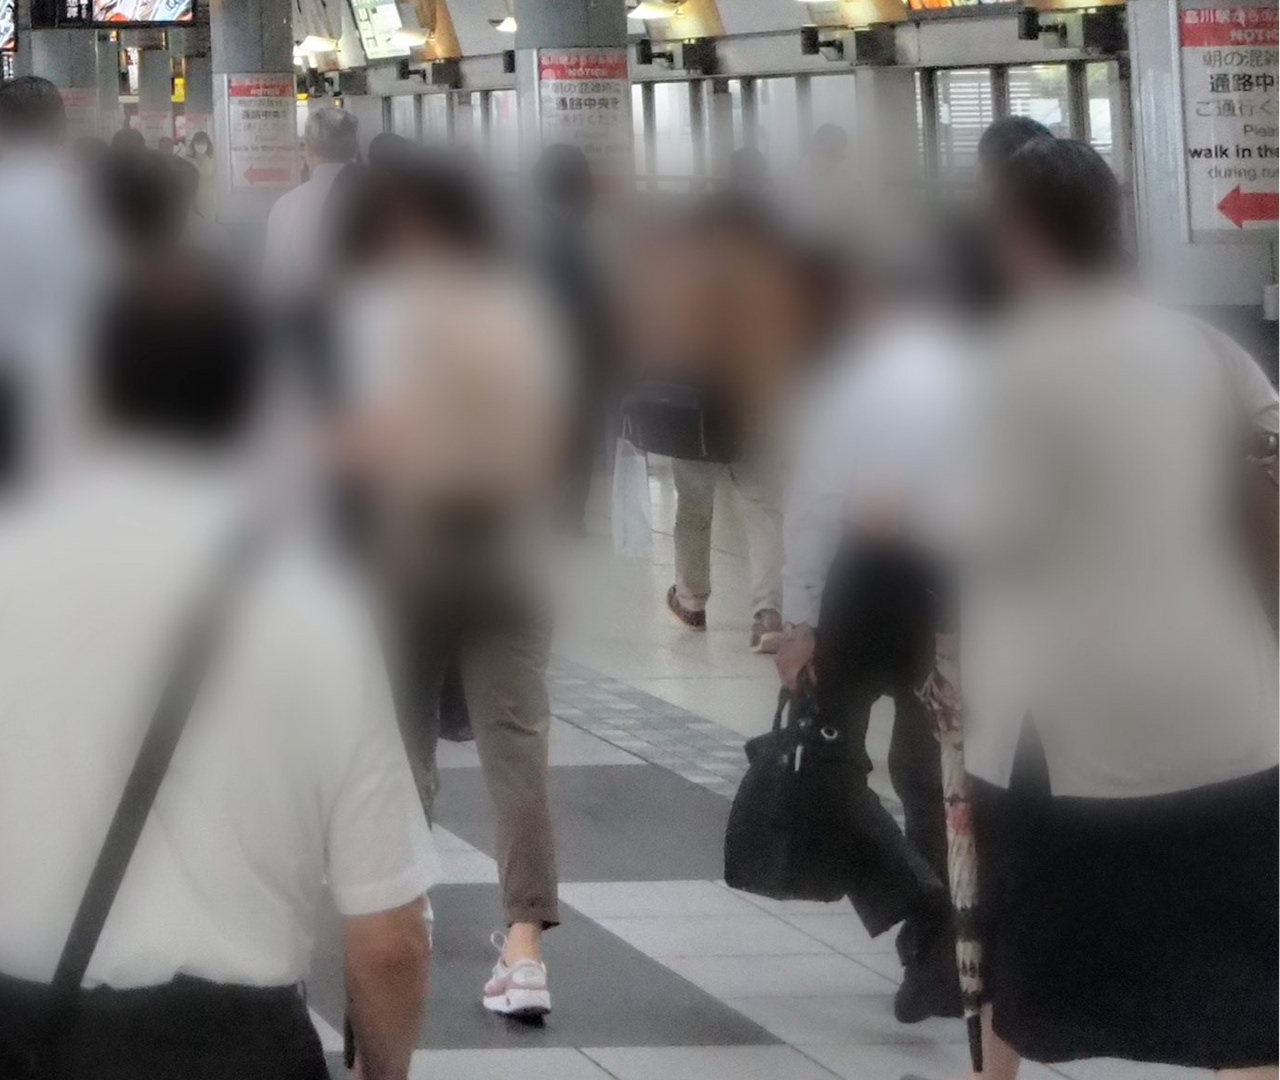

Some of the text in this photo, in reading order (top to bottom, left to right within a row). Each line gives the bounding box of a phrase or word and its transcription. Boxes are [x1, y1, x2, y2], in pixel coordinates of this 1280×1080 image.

[1183, 9, 1278, 26] 品川駅からの
[1209, 73, 1278, 93] 通路中
[1196, 99, 1278, 117] ご通行く
[1243, 124, 1278, 137] Plea
[1189, 145, 1228, 159] walk
[1235, 145, 1252, 159] in
[1208, 166, 1256, 182] during
